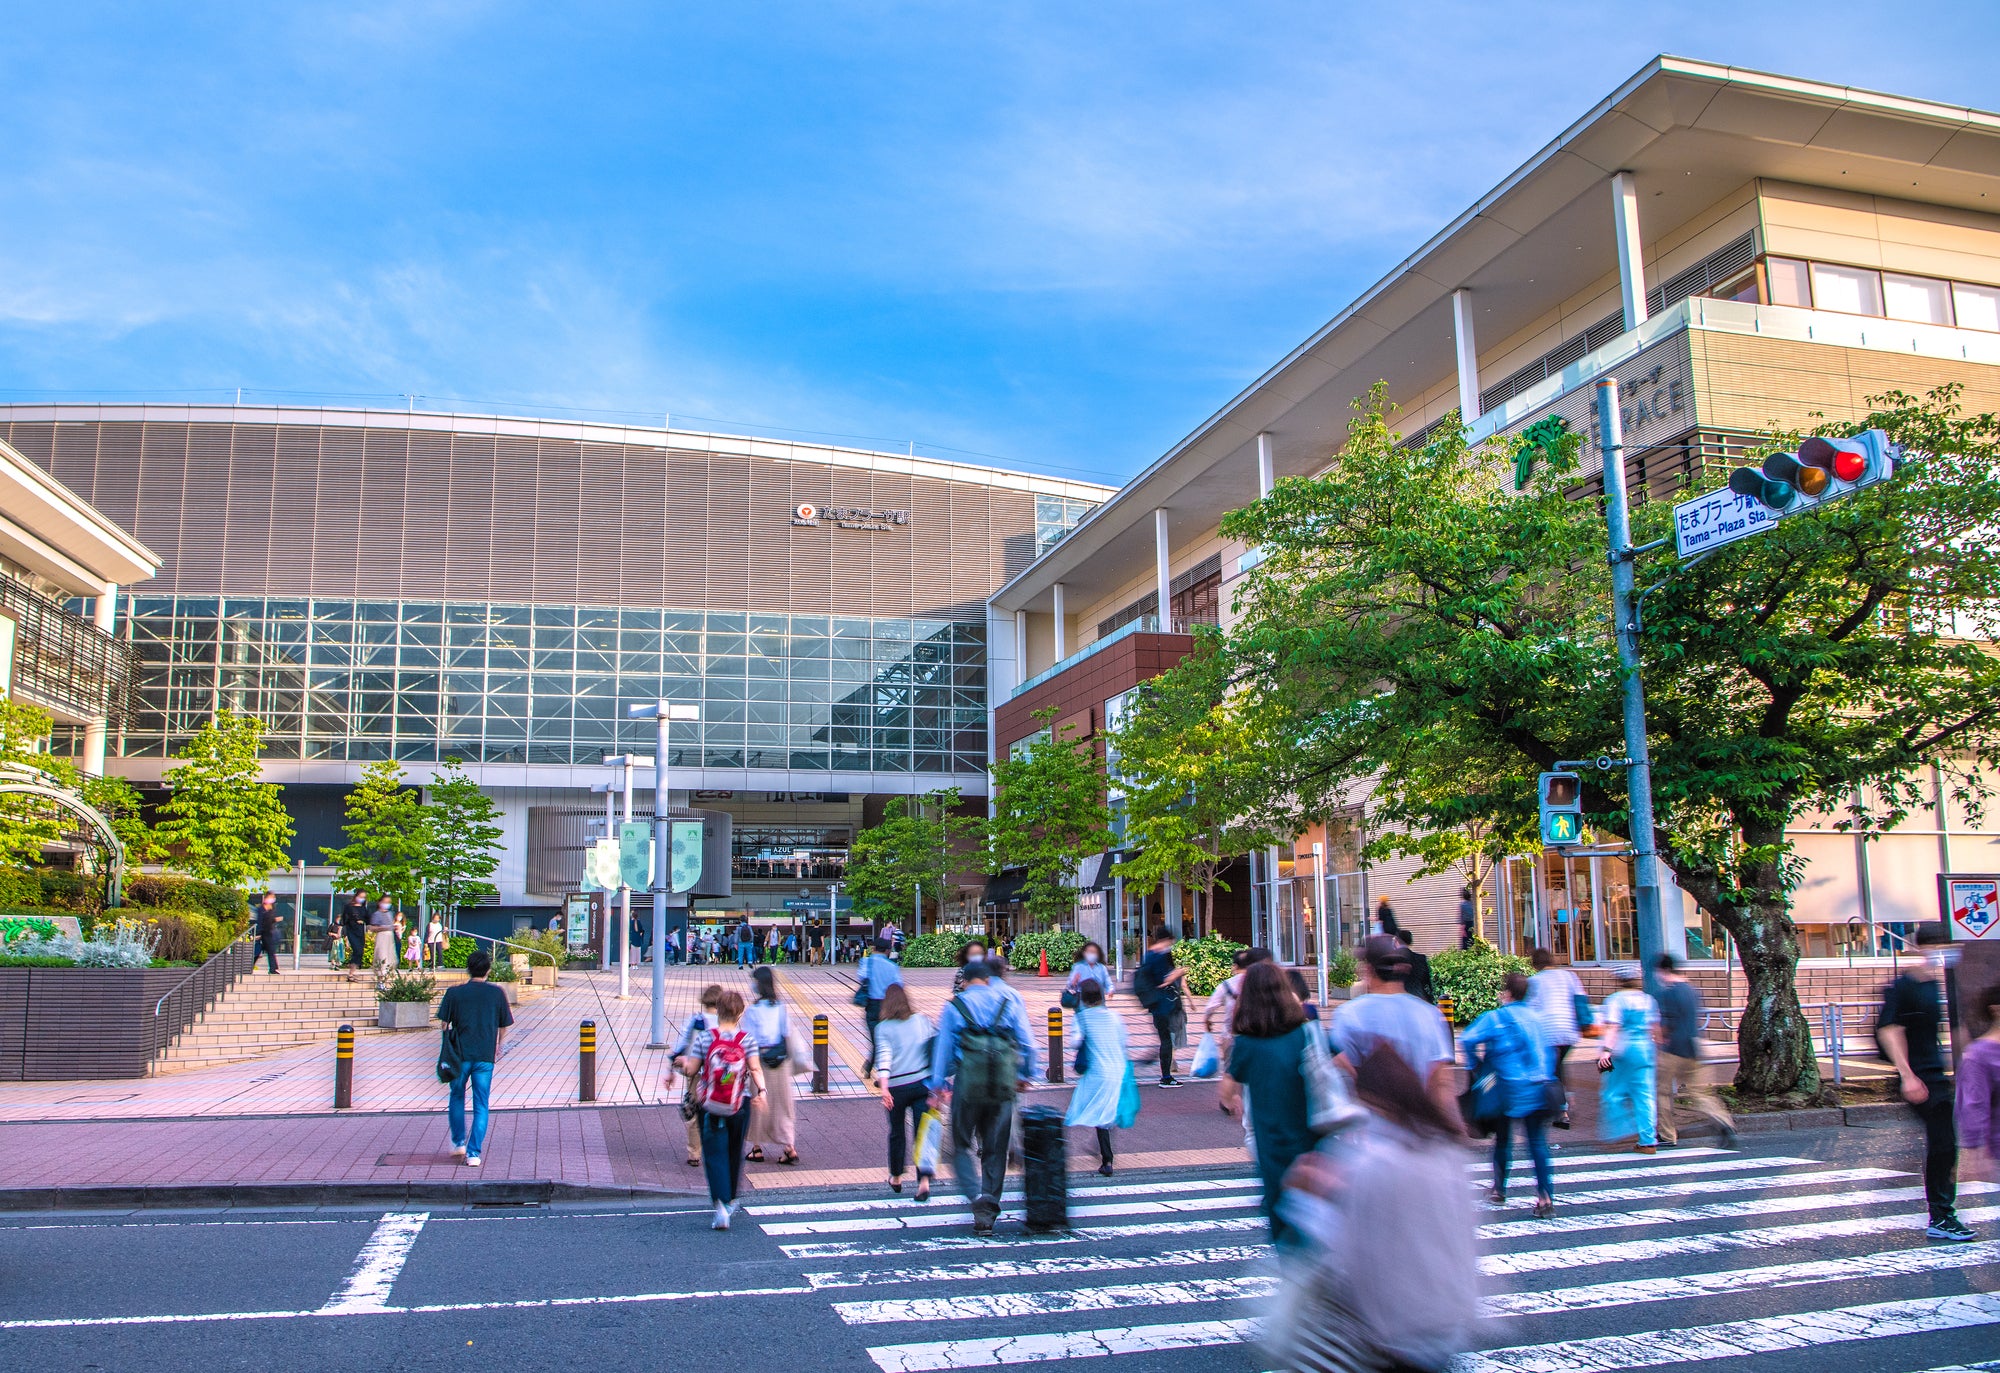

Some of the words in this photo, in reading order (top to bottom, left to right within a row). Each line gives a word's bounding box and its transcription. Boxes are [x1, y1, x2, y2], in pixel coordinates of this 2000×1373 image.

[823, 506, 910, 525] たまプラーザ駅
[1683, 519, 1745, 547] Tama-Plaza
